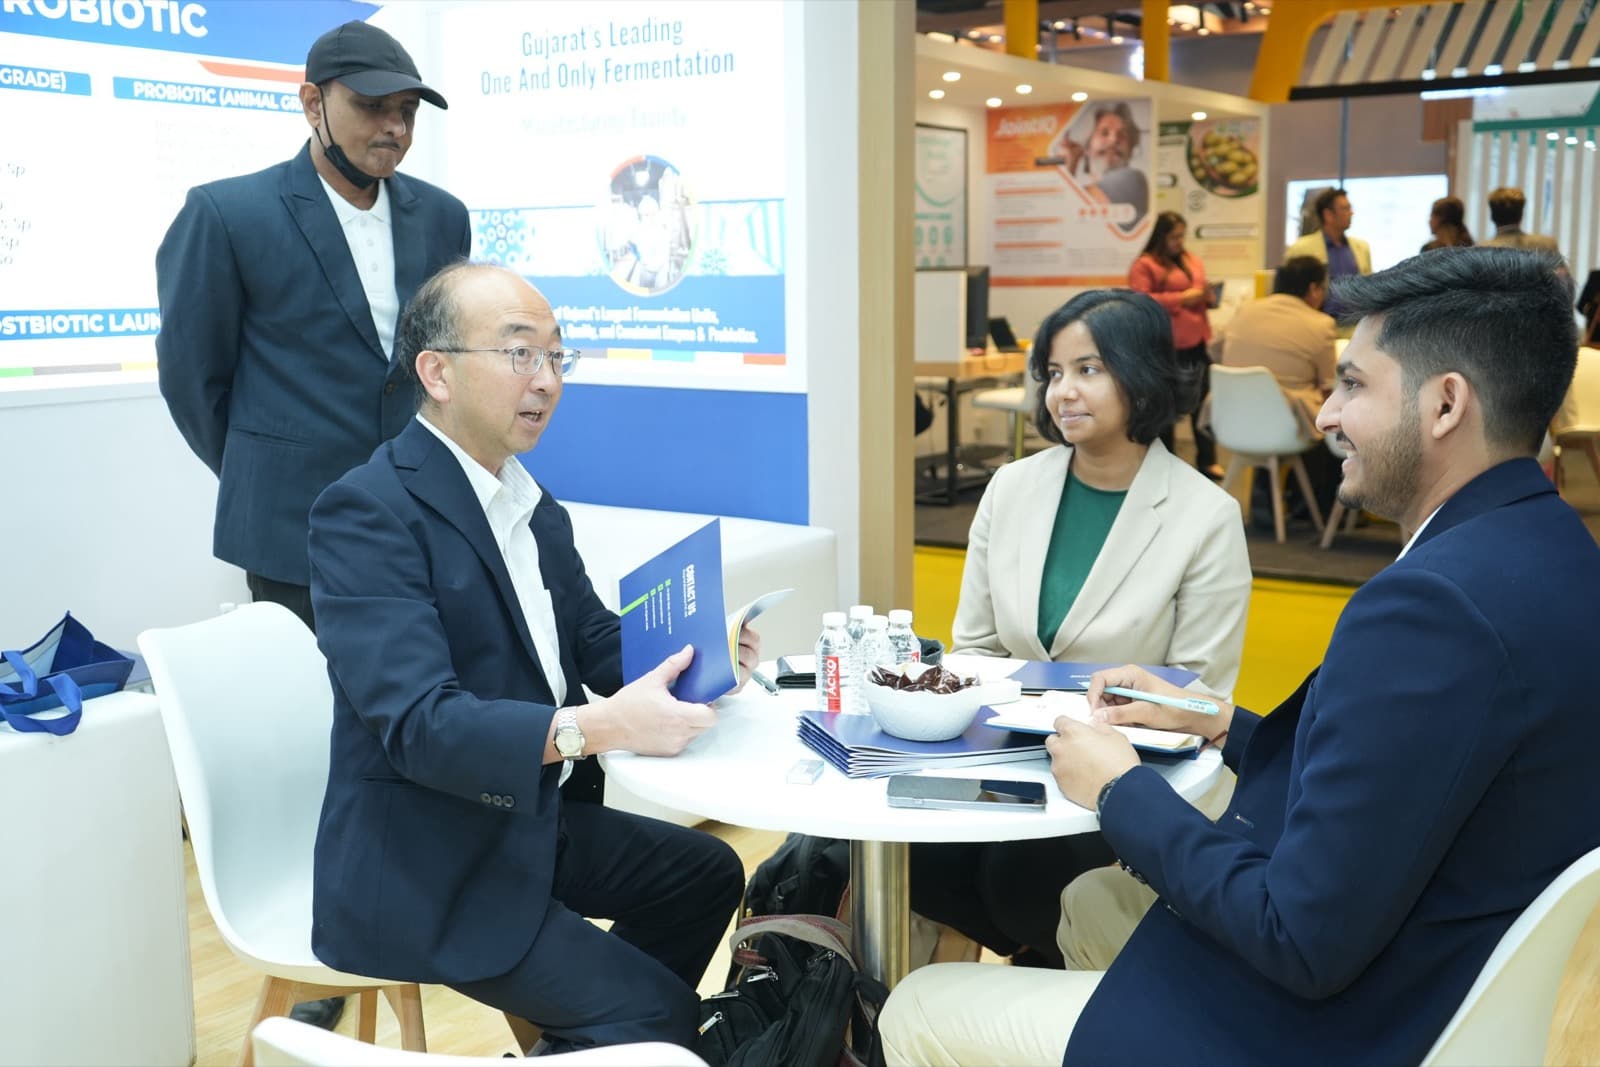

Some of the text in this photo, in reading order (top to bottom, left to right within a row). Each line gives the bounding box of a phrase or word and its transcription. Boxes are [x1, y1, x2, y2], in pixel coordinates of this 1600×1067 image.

[522, 17, 683, 60] Gujarat's Leading
[481, 49, 735, 95] One And Only Fermentation
[133, 81, 217, 104] PROBIOTIC
[219, 87, 279, 110] (ANIMAL
[0, 314, 104, 336] STBIOTIC
[827, 659, 838, 697] ACKO
